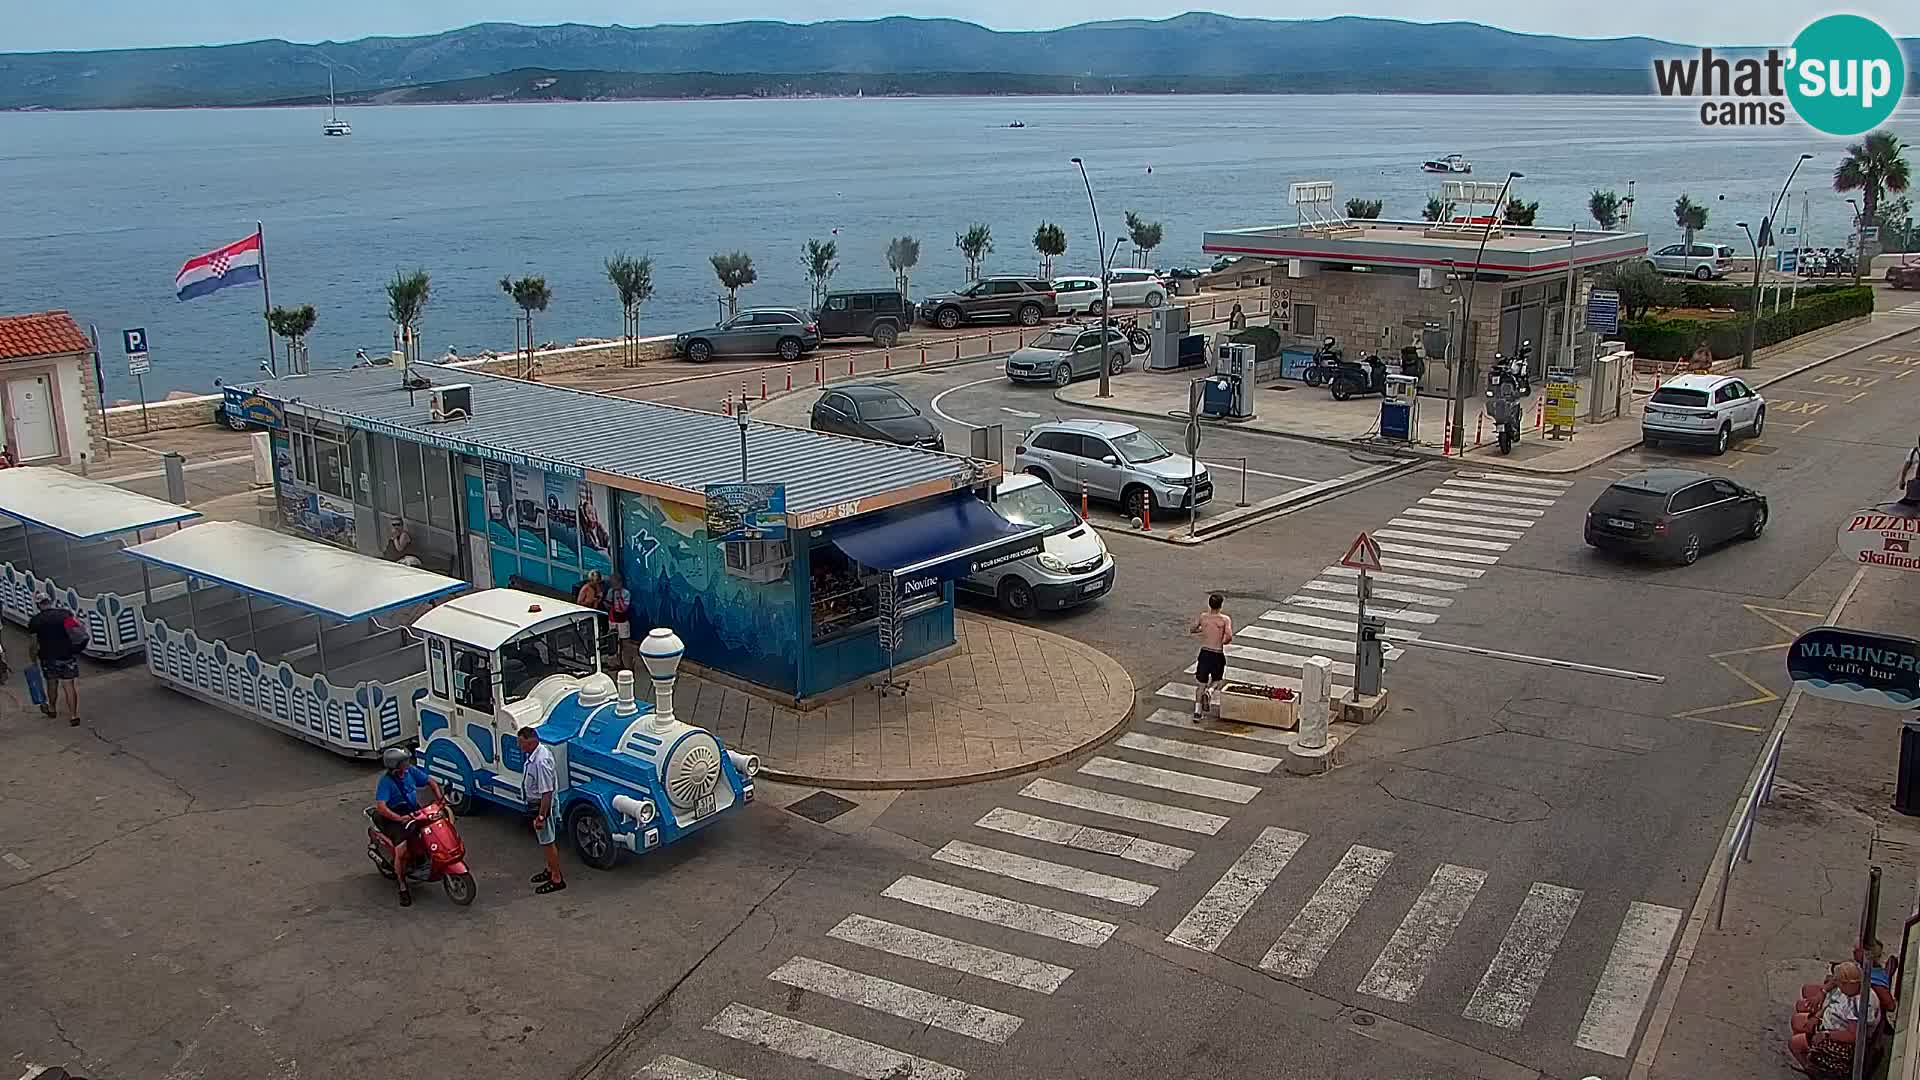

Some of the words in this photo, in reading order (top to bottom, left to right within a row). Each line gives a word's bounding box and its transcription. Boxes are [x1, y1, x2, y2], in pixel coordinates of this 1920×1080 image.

[128, 331, 142, 350] P
[435, 436, 468, 453] POSTAJA
[477, 446, 493, 458] BUS
[493, 450, 526, 466] STATION
[527, 457, 553, 472] TICKET
[553, 463, 582, 478] OFFICE
[1848, 515, 1920, 534] PIZZE
[1880, 530, 1918, 541] GRILL
[1828, 662, 1865, 676] caffe
[1869, 665, 1896, 680] bar
